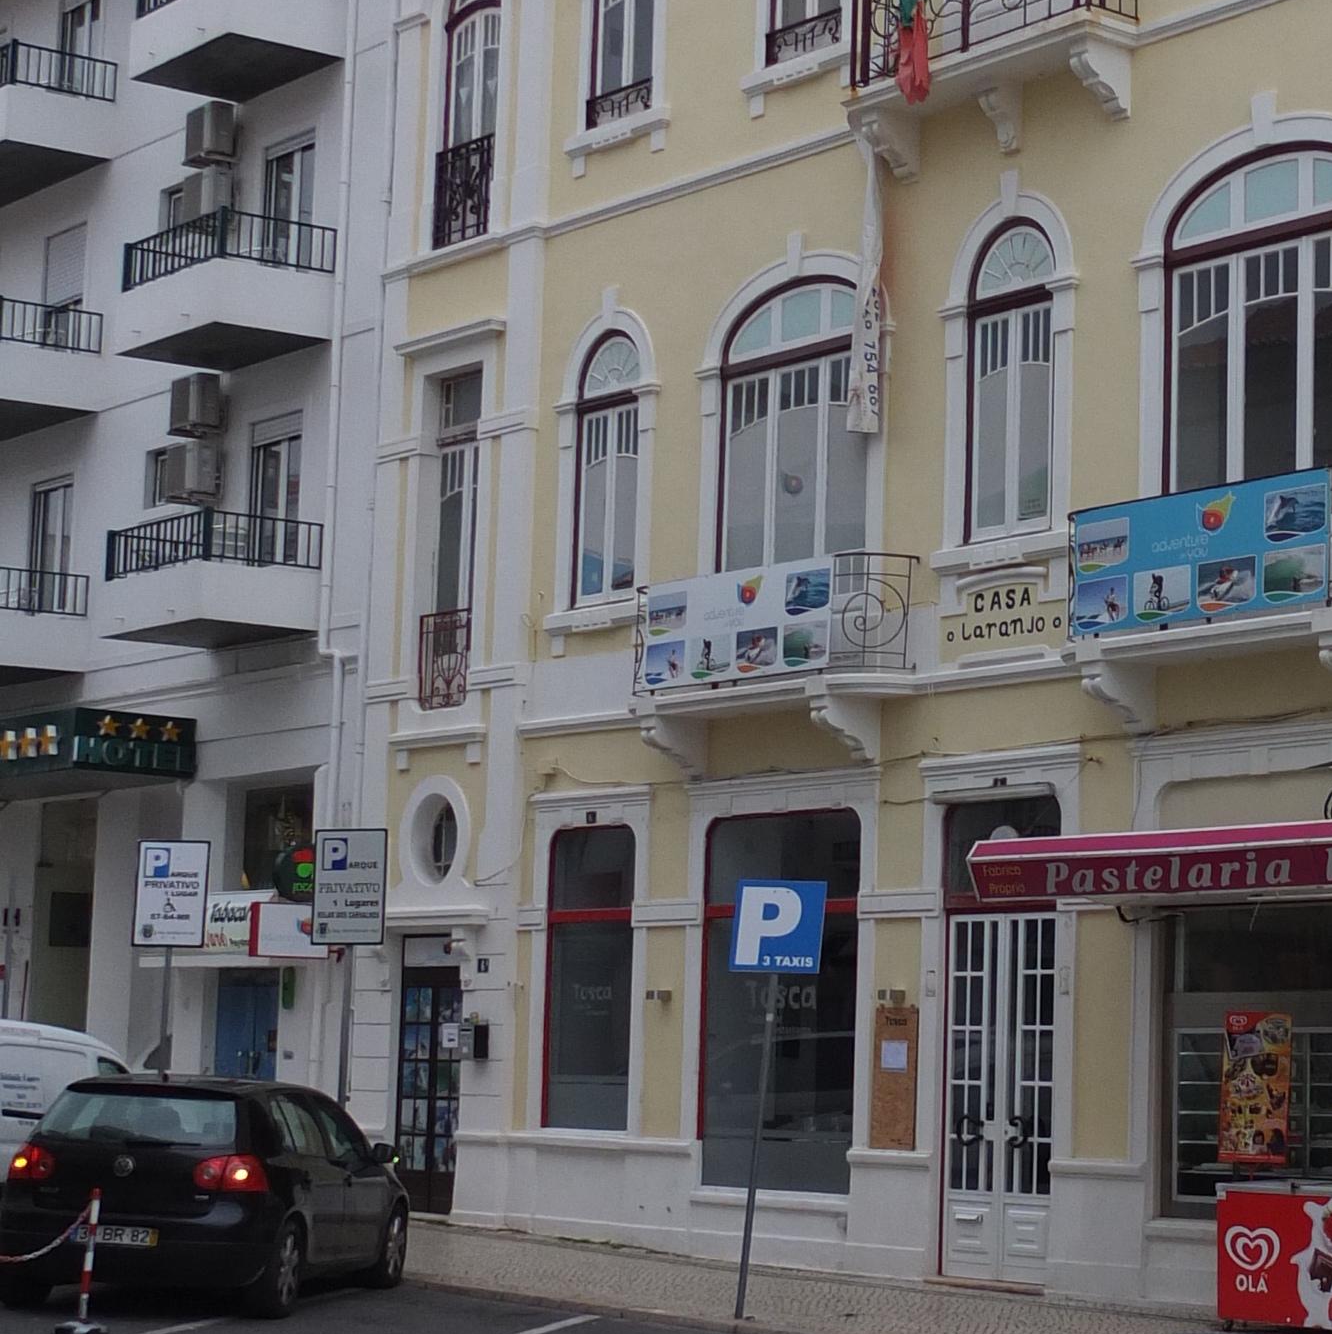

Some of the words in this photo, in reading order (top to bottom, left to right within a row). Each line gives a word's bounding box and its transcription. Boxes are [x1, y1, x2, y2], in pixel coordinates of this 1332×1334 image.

[974, 587, 1031, 613] CASA
[73, 735, 196, 772] HOTEL
[144, 880, 200, 889] PRIVATIVO
[1045, 851, 1292, 895] Pastelaria
[318, 882, 381, 894] PRIVATIVO
[735, 886, 802, 966] P
[762, 955, 771, 966] 3
[774, 955, 814, 968] TAXIS
[1235, 1272, 1269, 1294] OLÁ
